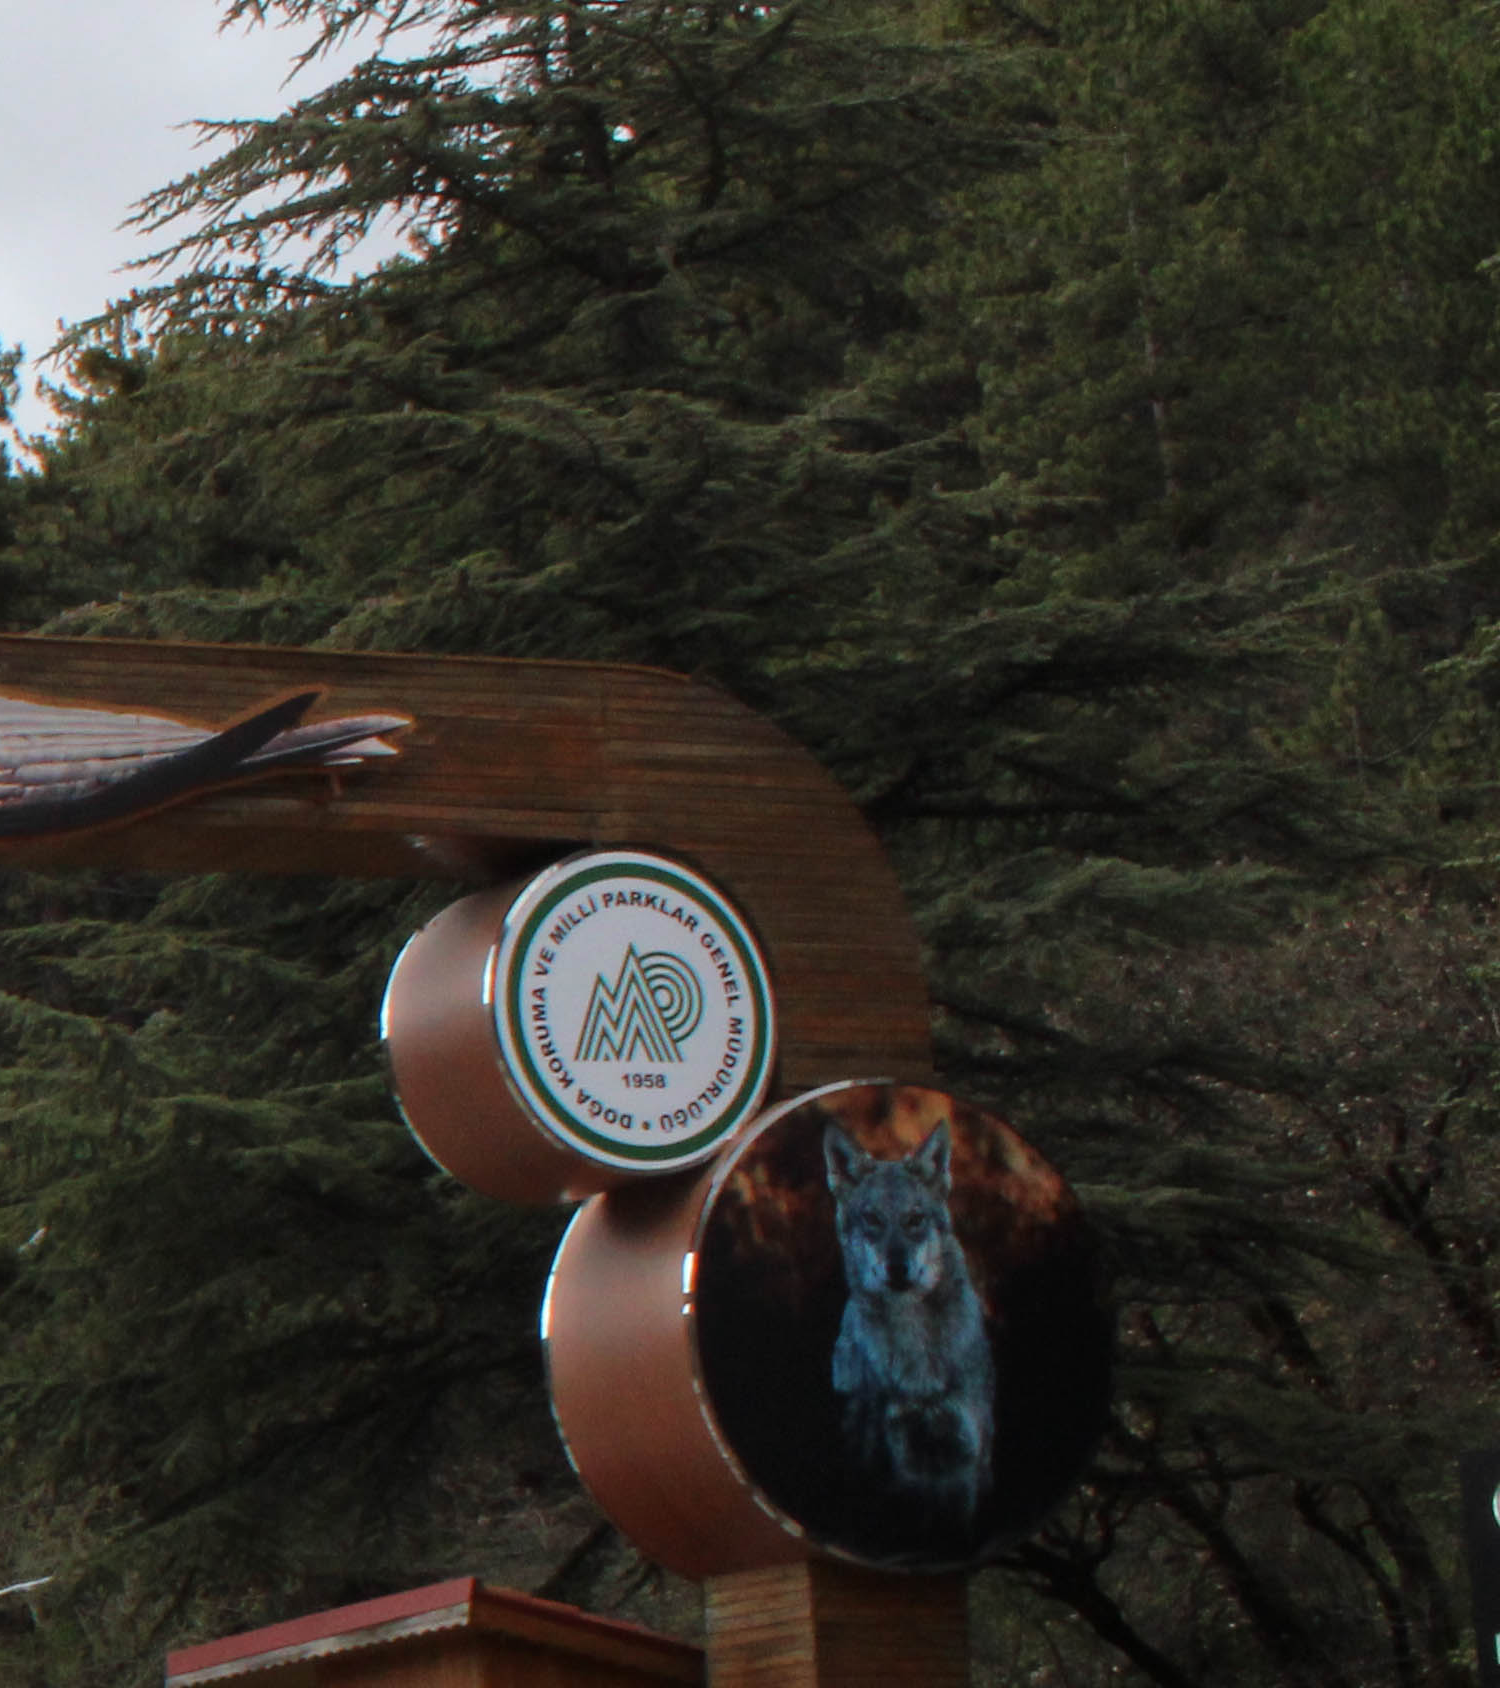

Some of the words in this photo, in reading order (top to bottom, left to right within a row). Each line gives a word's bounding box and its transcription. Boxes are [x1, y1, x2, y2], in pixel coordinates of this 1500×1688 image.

[548, 895, 599, 945] MİLLİ
[602, 891, 699, 932] PARKLAR
[535, 947, 556, 977] VE
[701, 932, 742, 1008] GENEL
[531, 986, 575, 1089] KORUMA
[621, 1073, 666, 1089] 1958
[660, 1016, 744, 1132] MÜDÜRLÜĞÜ
[576, 1089, 632, 1130] DOĞA
